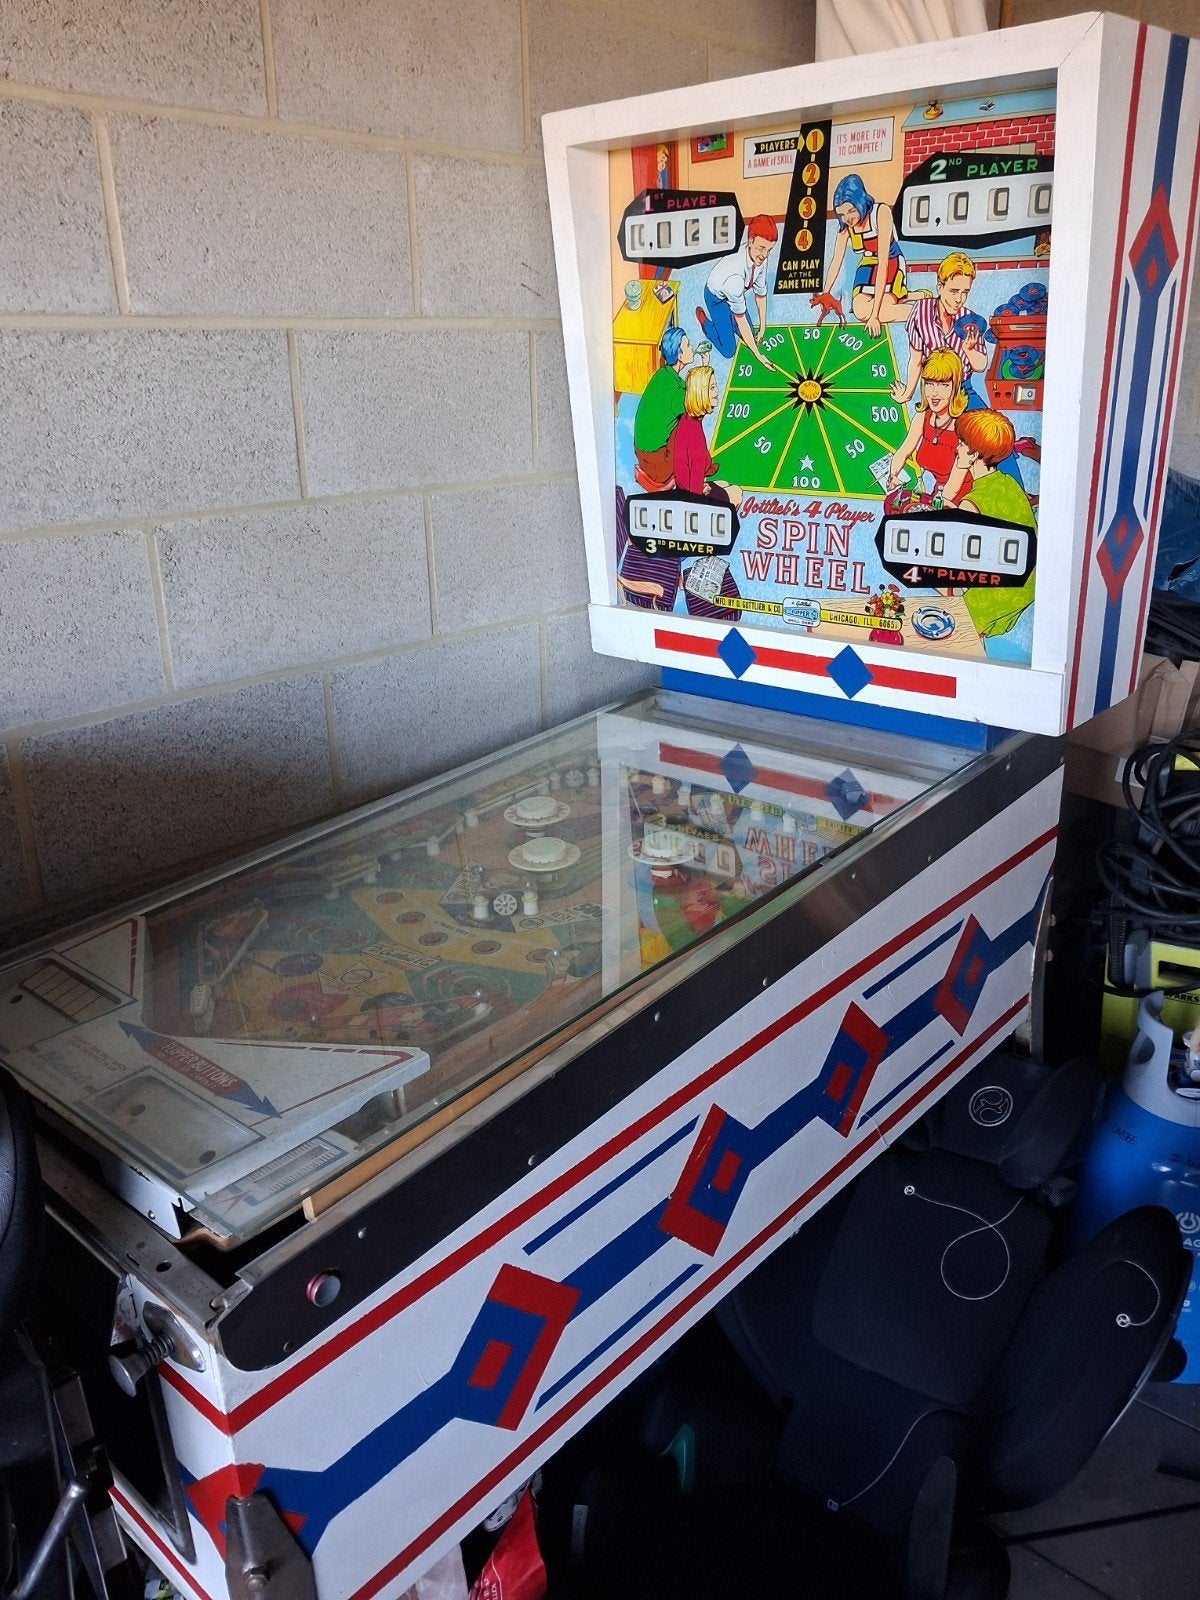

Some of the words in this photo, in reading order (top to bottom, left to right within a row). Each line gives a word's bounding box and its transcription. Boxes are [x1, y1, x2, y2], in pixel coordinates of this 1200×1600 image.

[810, 131, 818, 151] 1
[836, 133, 848, 144] IT'S
[850, 131, 869, 142] MORE
[872, 128, 887, 139] FUN
[760, 139, 795, 153] PLAYERS
[838, 146, 846, 157] TO
[747, 160, 752, 169] A
[753, 156, 769, 168] GAME
[777, 154, 793, 166] SKILL
[966, 158, 1039, 178] PLAYER
[805, 164, 817, 184] 2
[667, 194, 717, 209] PLAYER
[803, 198, 813, 218] 3
[797, 230, 808, 249] 4
[782, 260, 798, 271] CAN
[800, 259, 820, 270] PLAY
[777, 279, 799, 290] SAME
[800, 278, 820, 288] TIME
[762, 333, 785, 352] 300
[803, 328, 820, 340] 50
[837, 333, 863, 351] 400
[738, 364, 753, 377] 50
[871, 364, 887, 377] 50
[726, 403, 750, 418] 200
[871, 405, 899, 423] 500
[753, 435, 772, 454] 50
[844, 438, 865, 459] 50
[792, 475, 821, 489] 100
[740, 496, 800, 519] Gottlieb's
[803, 501, 822, 518] 4
[824, 502, 876, 530] Player
[756, 517, 851, 557] SPIN
[668, 541, 714, 554] PLAYER
[740, 549, 871, 594] WHEEL
[937, 568, 1001, 585] PLAYER
[728, 598, 735, 606] BY
[161, 1041, 199, 1066] FLIPPER
[193, 1060, 238, 1089] BUTTONS
